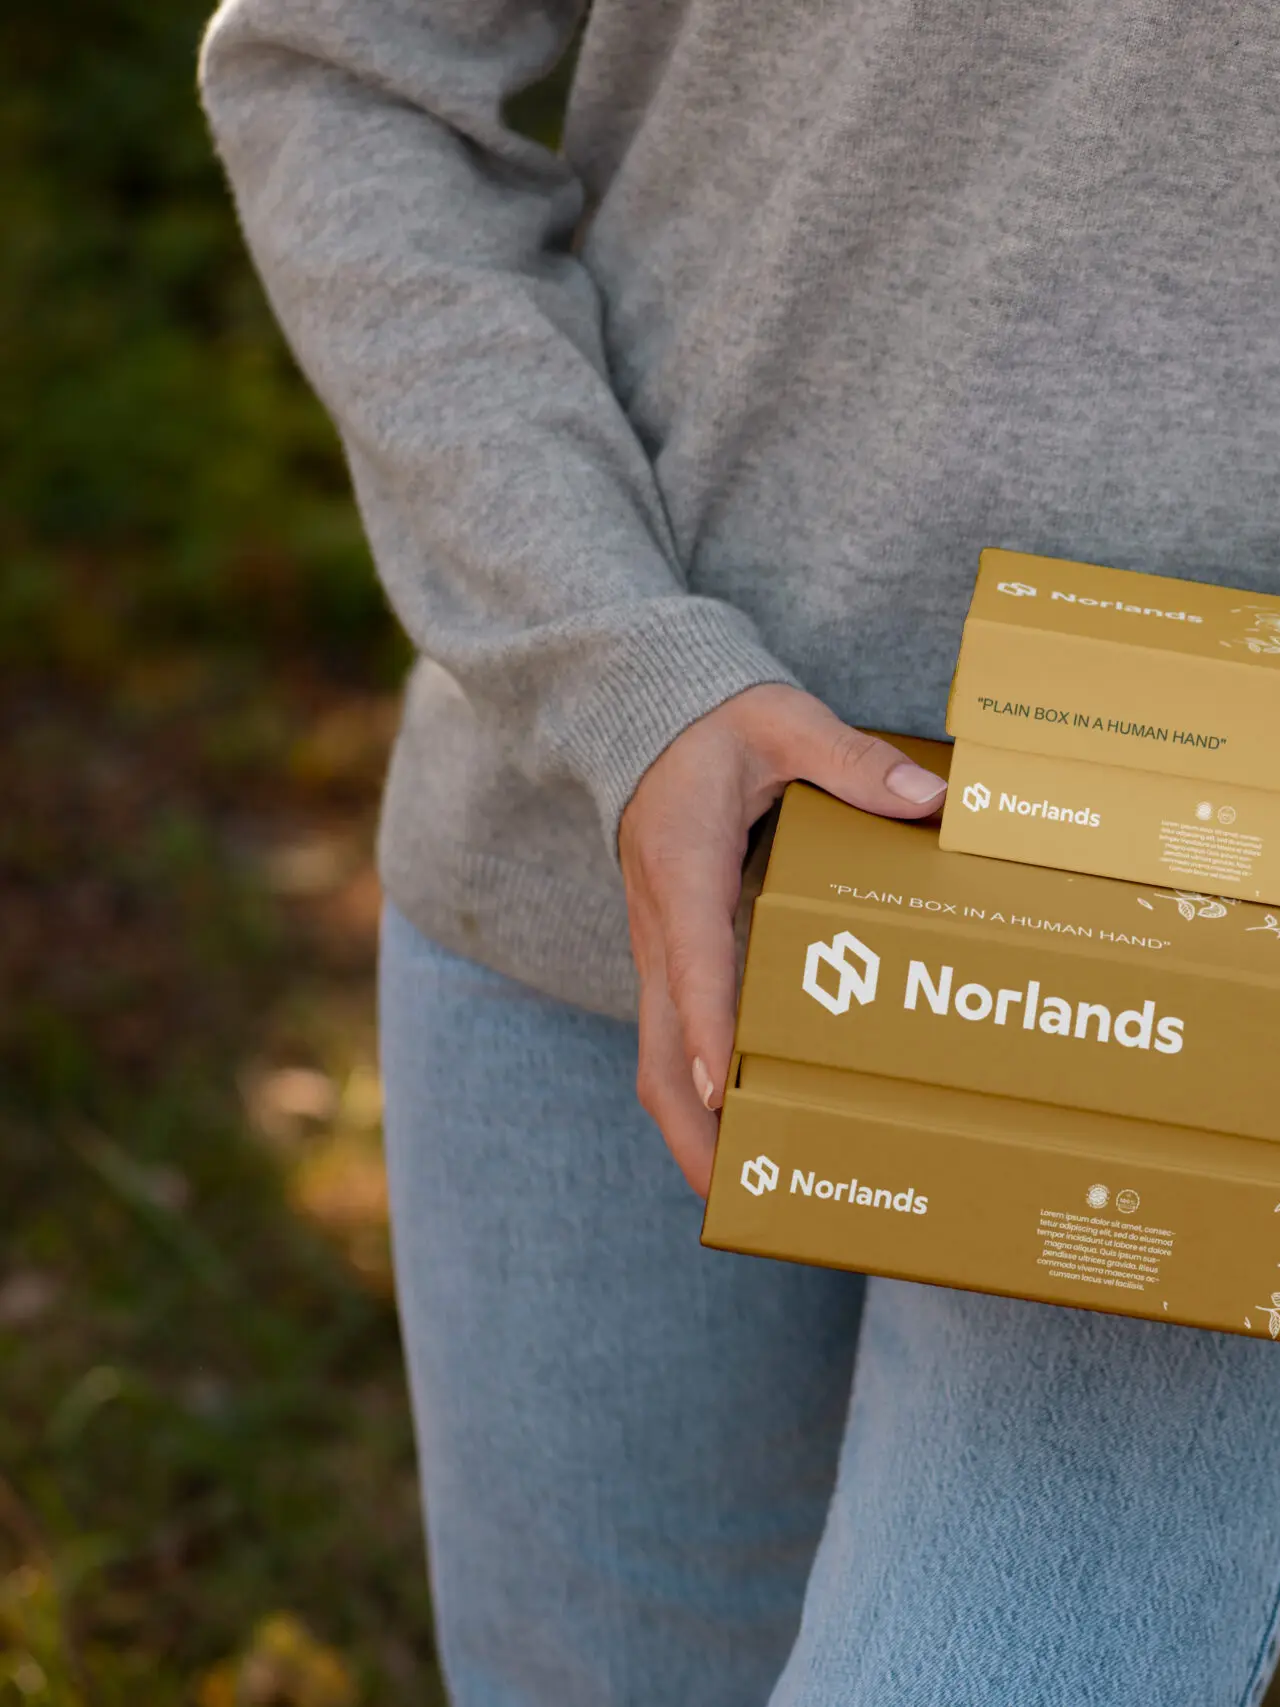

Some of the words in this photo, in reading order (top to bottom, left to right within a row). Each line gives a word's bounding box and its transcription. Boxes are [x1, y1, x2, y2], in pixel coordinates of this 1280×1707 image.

[1051, 592, 1202, 623] Norlands
[976, 696, 1031, 718] "PLAIN
[1033, 706, 1070, 726] BOX
[1072, 713, 1090, 729] IN
[1091, 716, 1104, 731] A
[1106, 719, 1169, 742] HUMAN
[1171, 730, 1227, 751] HAND"
[999, 793, 1100, 827] Norlands
[828, 882, 903, 906] "PLAIN
[907, 896, 958, 914] BOX
[963, 906, 986, 920] IN
[990, 911, 1007, 923] A
[1010, 913, 1094, 938] HUMAN
[1098, 928, 1171, 951] HAND"
[904, 960, 1184, 1054] Norlands
[790, 1169, 928, 1214] Norlands
[1039, 1208, 1065, 1219] Lorem
[1064, 1212, 1090, 1223] ipsum
[1089, 1217, 1110, 1227] dolor
[1110, 1220, 1120, 1228] sit
[1120, 1222, 1143, 1232] amet,
[1039, 1218, 1058, 1228] tetur
[1058, 1221, 1099, 1236] adipiscing
[1098, 1228, 1112, 1237] elit,
[1113, 1231, 1128, 1239] sed
[1127, 1232, 1139, 1241] do
[1138, 1235, 1173, 1247] eiusmod
